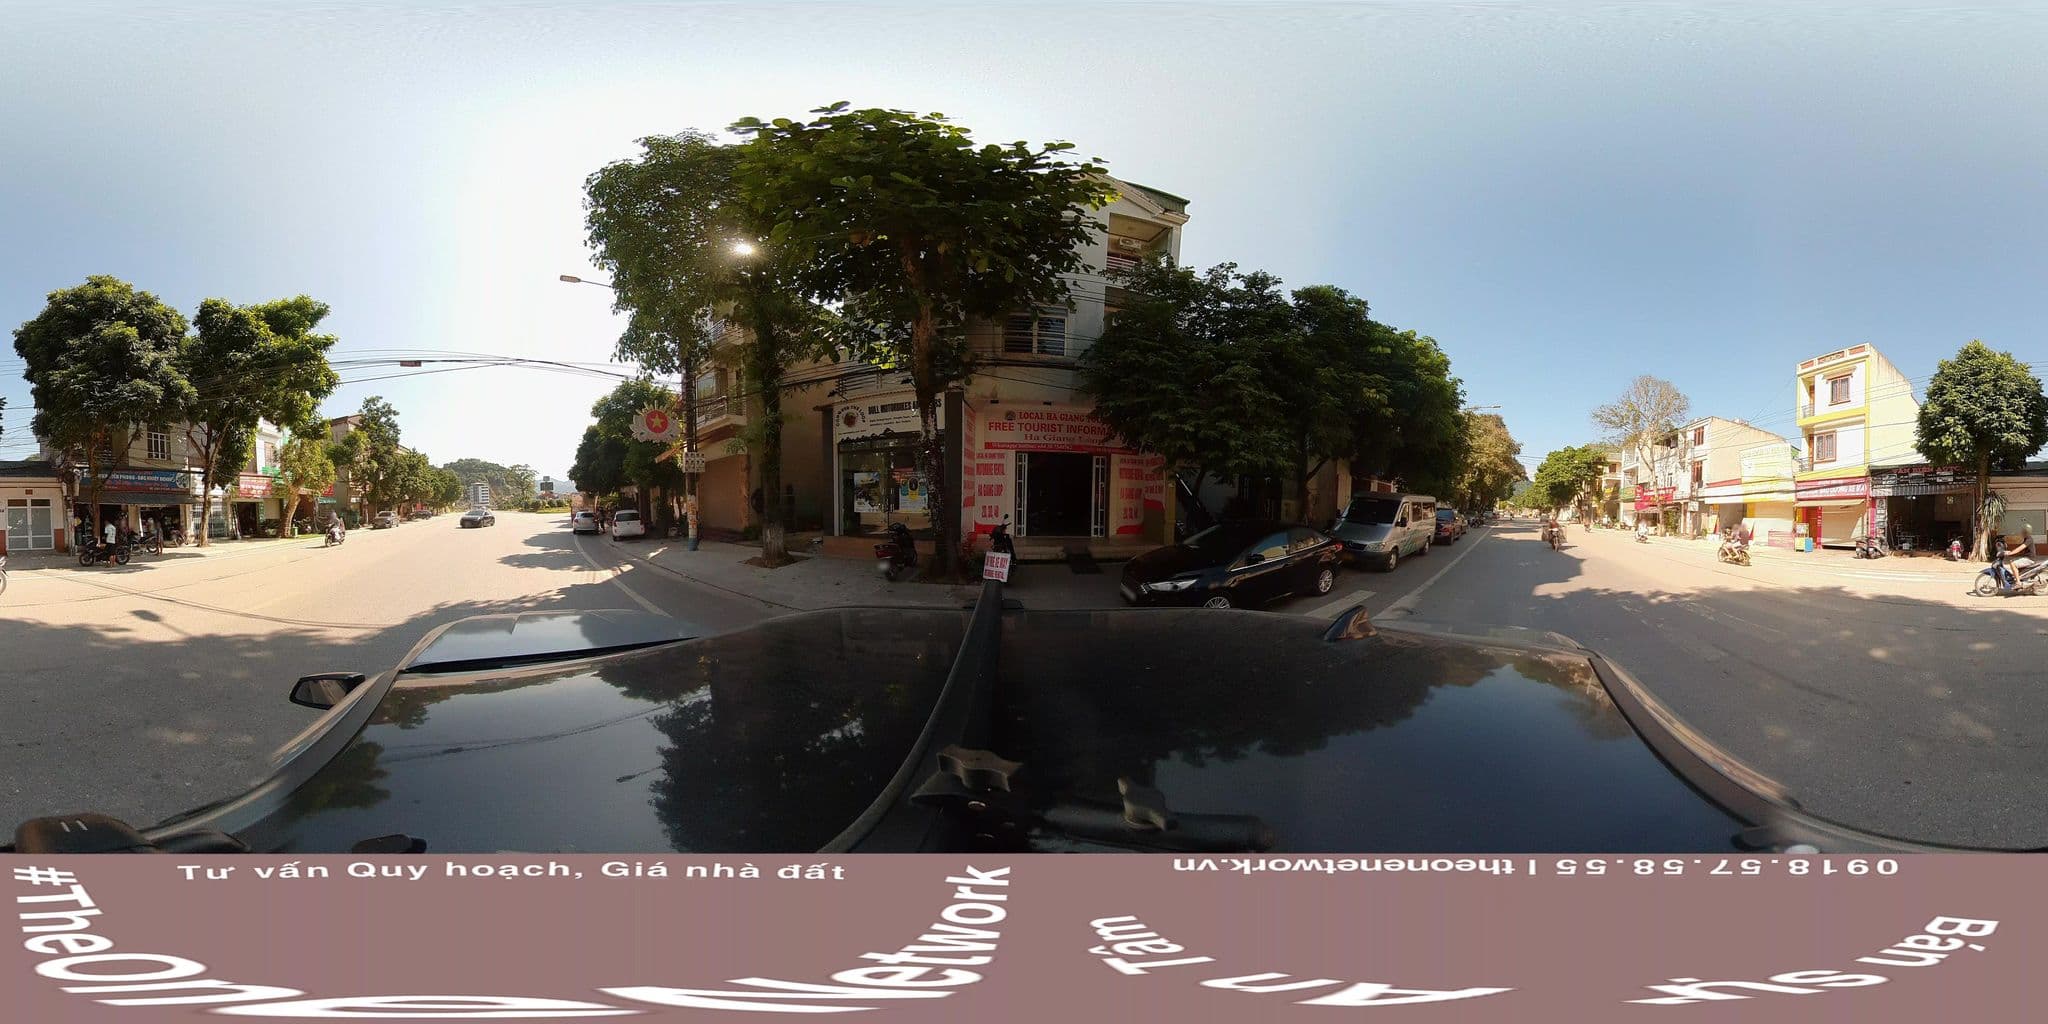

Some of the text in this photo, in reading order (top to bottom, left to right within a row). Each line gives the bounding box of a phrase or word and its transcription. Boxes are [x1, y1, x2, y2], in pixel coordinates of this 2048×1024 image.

[1019, 411, 1045, 420] LOCAL
[1047, 412, 1058, 421] HA
[988, 421, 1114, 437] FREE TOURIST INFORMA
